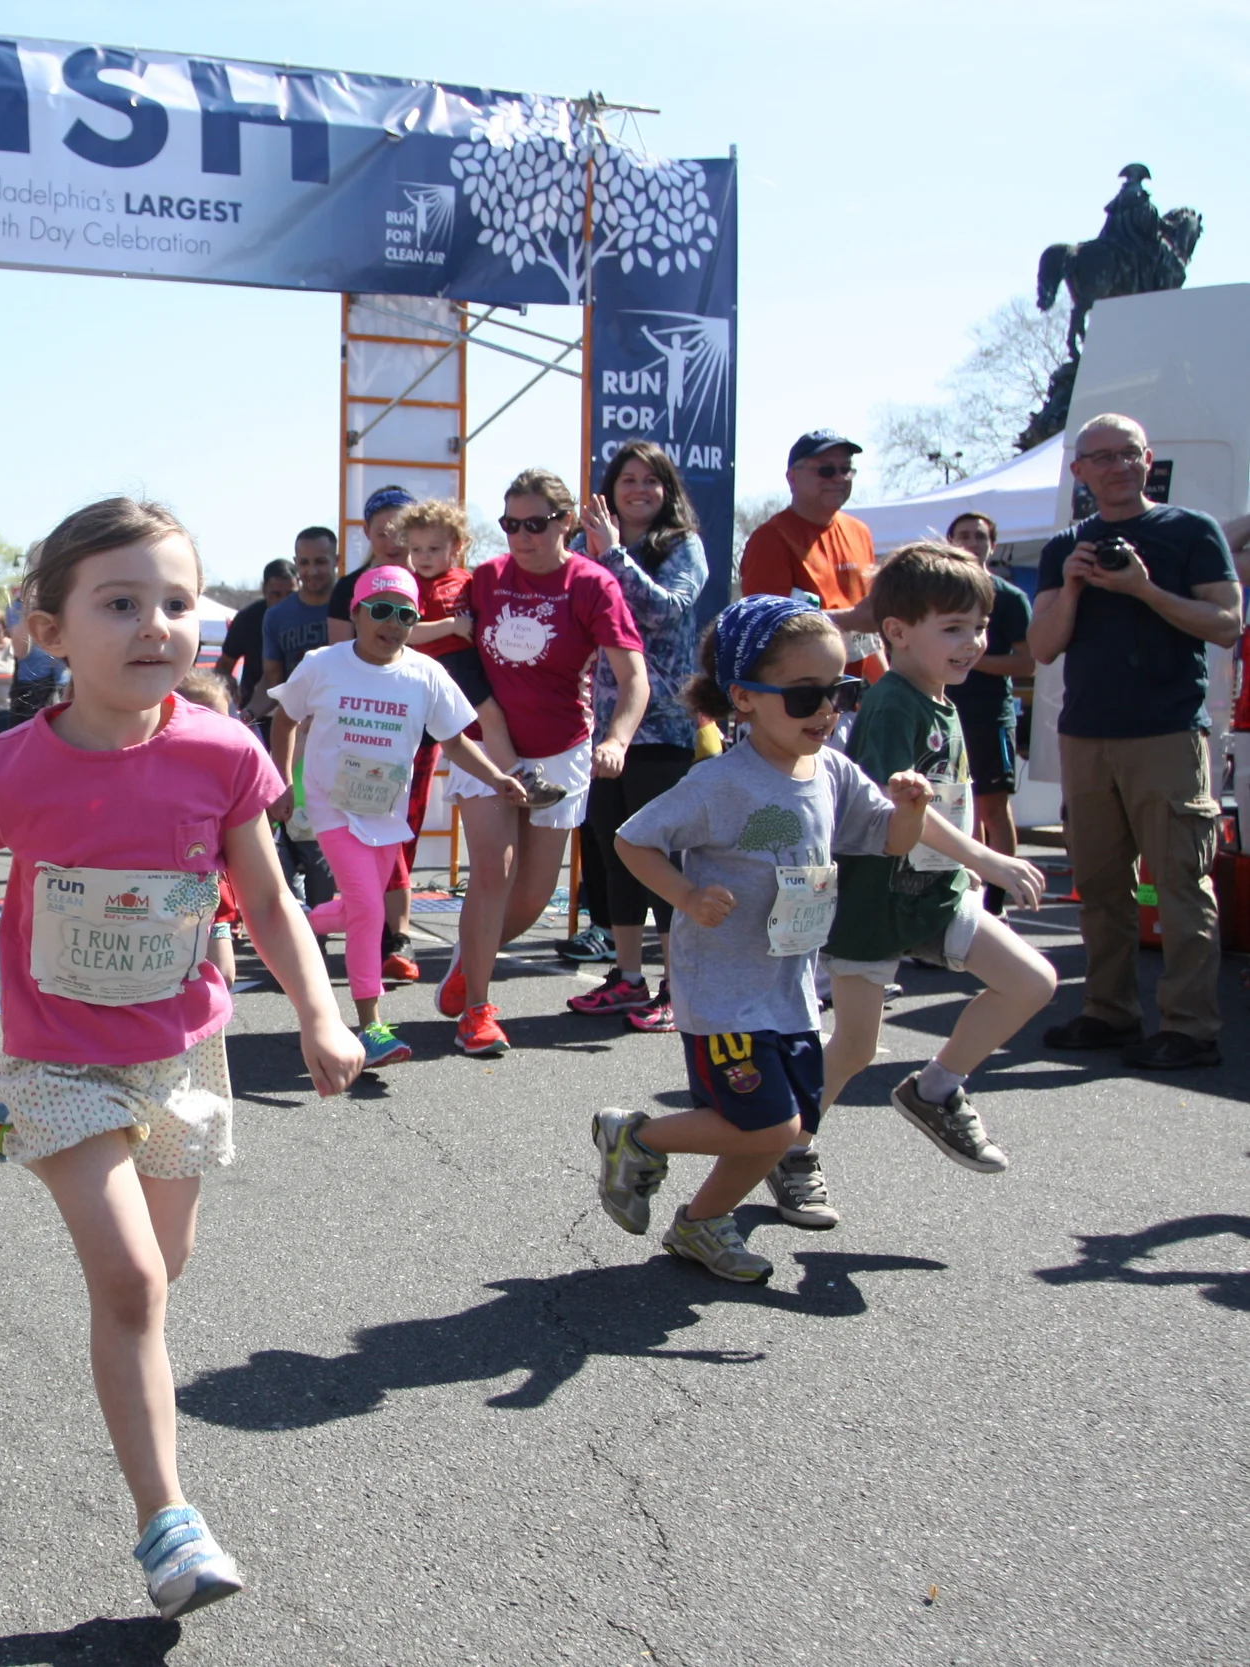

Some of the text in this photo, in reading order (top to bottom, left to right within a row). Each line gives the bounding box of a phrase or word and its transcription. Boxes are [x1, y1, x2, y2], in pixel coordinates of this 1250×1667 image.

[124, 192, 243, 223] LARGEST
[386, 210, 415, 226] RUN
[29, 216, 75, 250] Day
[83, 221, 211, 255] Celebration
[386, 228, 411, 243] FOR
[385, 247, 446, 265] CLEAN AIR
[602, 370, 661, 395] RUN
[602, 405, 655, 430] FOR
[687, 444, 722, 470] AIR
[339, 696, 408, 717] FUTURE
[338, 716, 402, 732] MARATHON
[344, 732, 392, 747] RUNNER
[47, 877, 85, 895] run
[785, 877, 806, 886] run
[46, 891, 84, 906] CLEAN
[47, 902, 66, 912] AIR
[72, 928, 174, 953] I RUN FOR
[71, 948, 175, 972] CLEAN AIR
